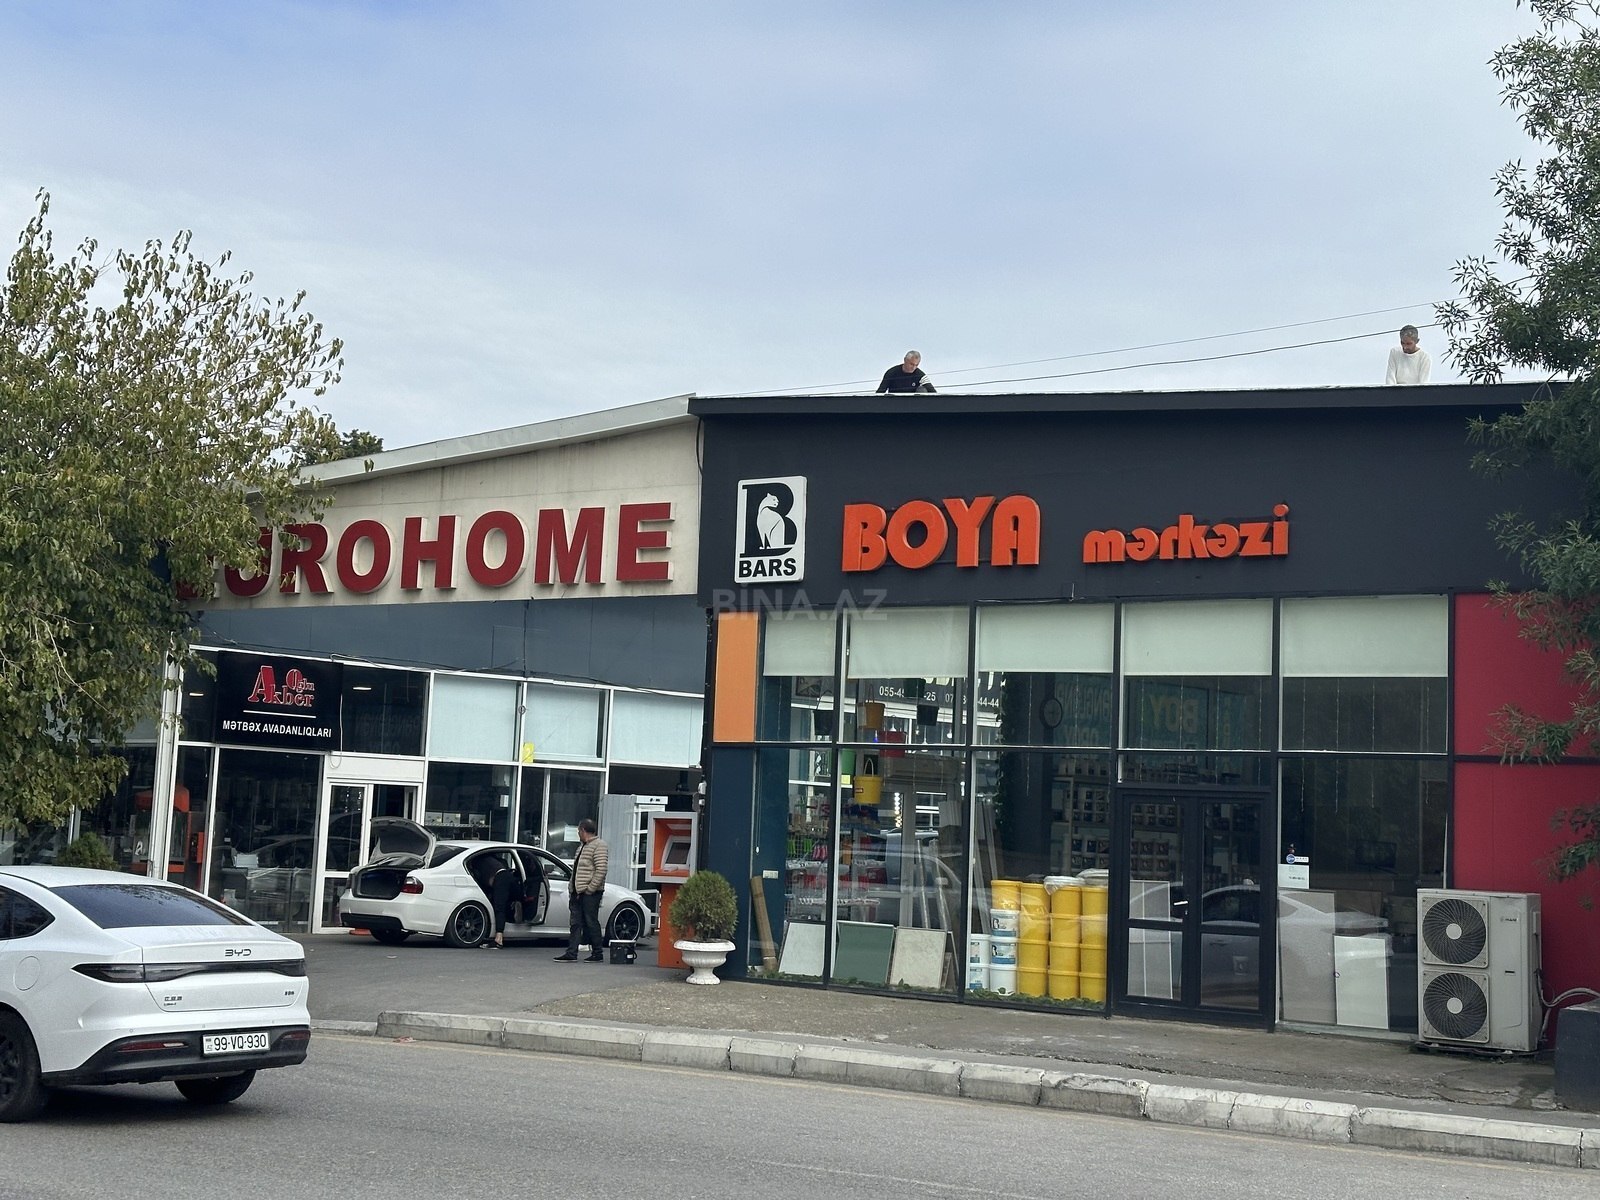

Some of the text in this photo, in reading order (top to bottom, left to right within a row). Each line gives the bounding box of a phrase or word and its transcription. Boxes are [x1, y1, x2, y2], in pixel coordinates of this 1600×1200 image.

[842, 495, 1290, 573] BOYA mərkəzi
[176, 502, 675, 600] UROHOME
[738, 558, 797, 578] BARS
[222, 719, 332, 738] MƏTBƏX AVADANLIQLARI
[224, 948, 252, 957] BYD
[213, 1034, 267, 1051] 99-VQ-930
